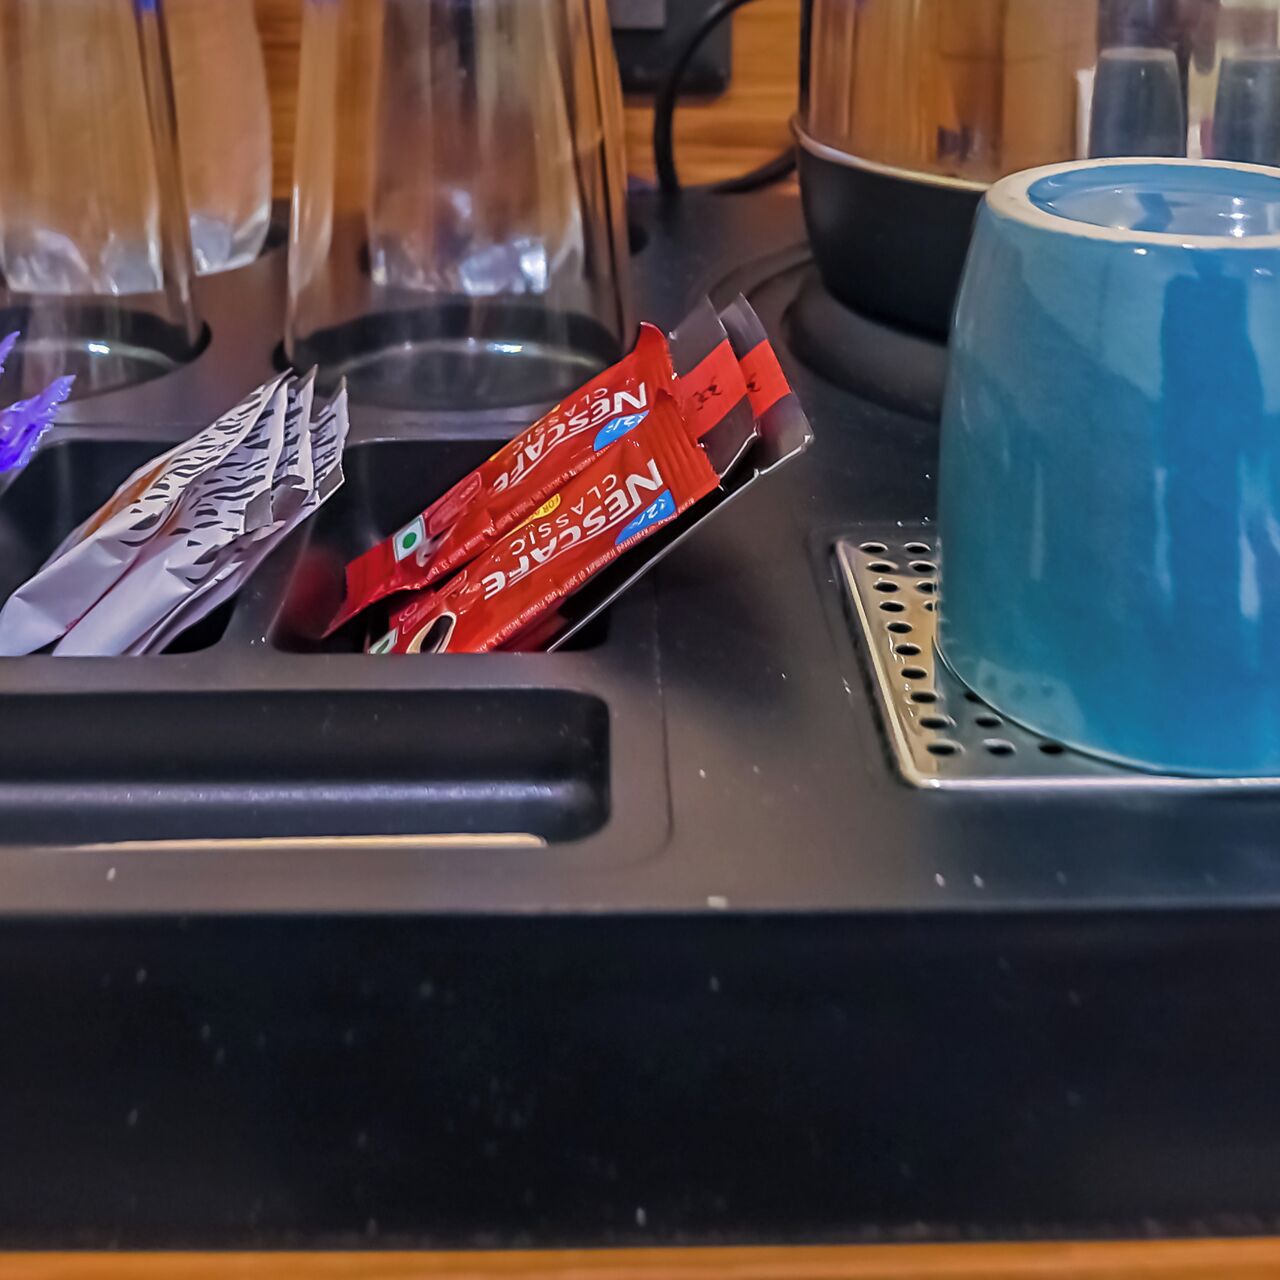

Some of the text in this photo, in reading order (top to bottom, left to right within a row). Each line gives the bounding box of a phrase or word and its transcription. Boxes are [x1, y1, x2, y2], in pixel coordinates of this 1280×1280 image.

[512, 387, 608, 457] CLASSIC
[481, 458, 663, 601] NESCAFE
[509, 474, 618, 556] CLASSIC
